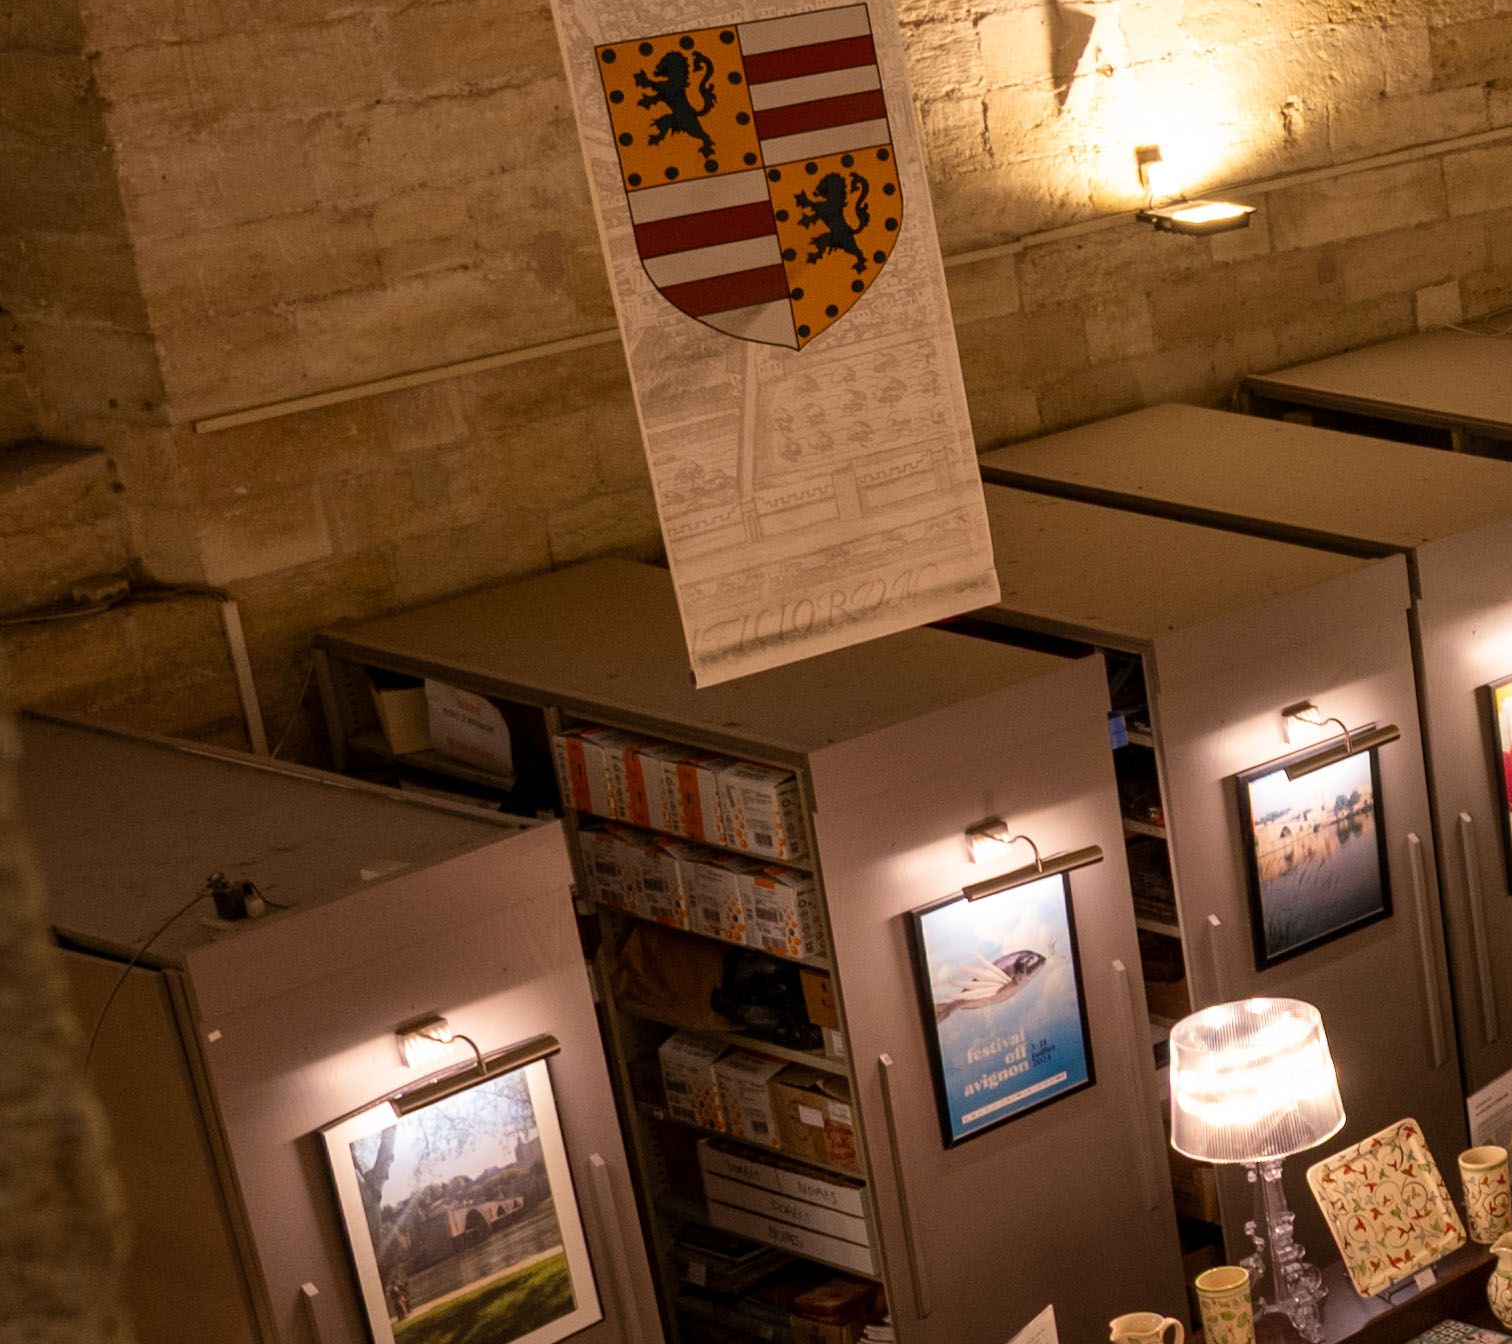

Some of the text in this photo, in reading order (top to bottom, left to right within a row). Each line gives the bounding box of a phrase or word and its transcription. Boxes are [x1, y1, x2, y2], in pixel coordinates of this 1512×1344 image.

[966, 1027, 1026, 1065] festival
[1004, 1042, 1028, 1066] off
[963, 1060, 1031, 1098] avignon
